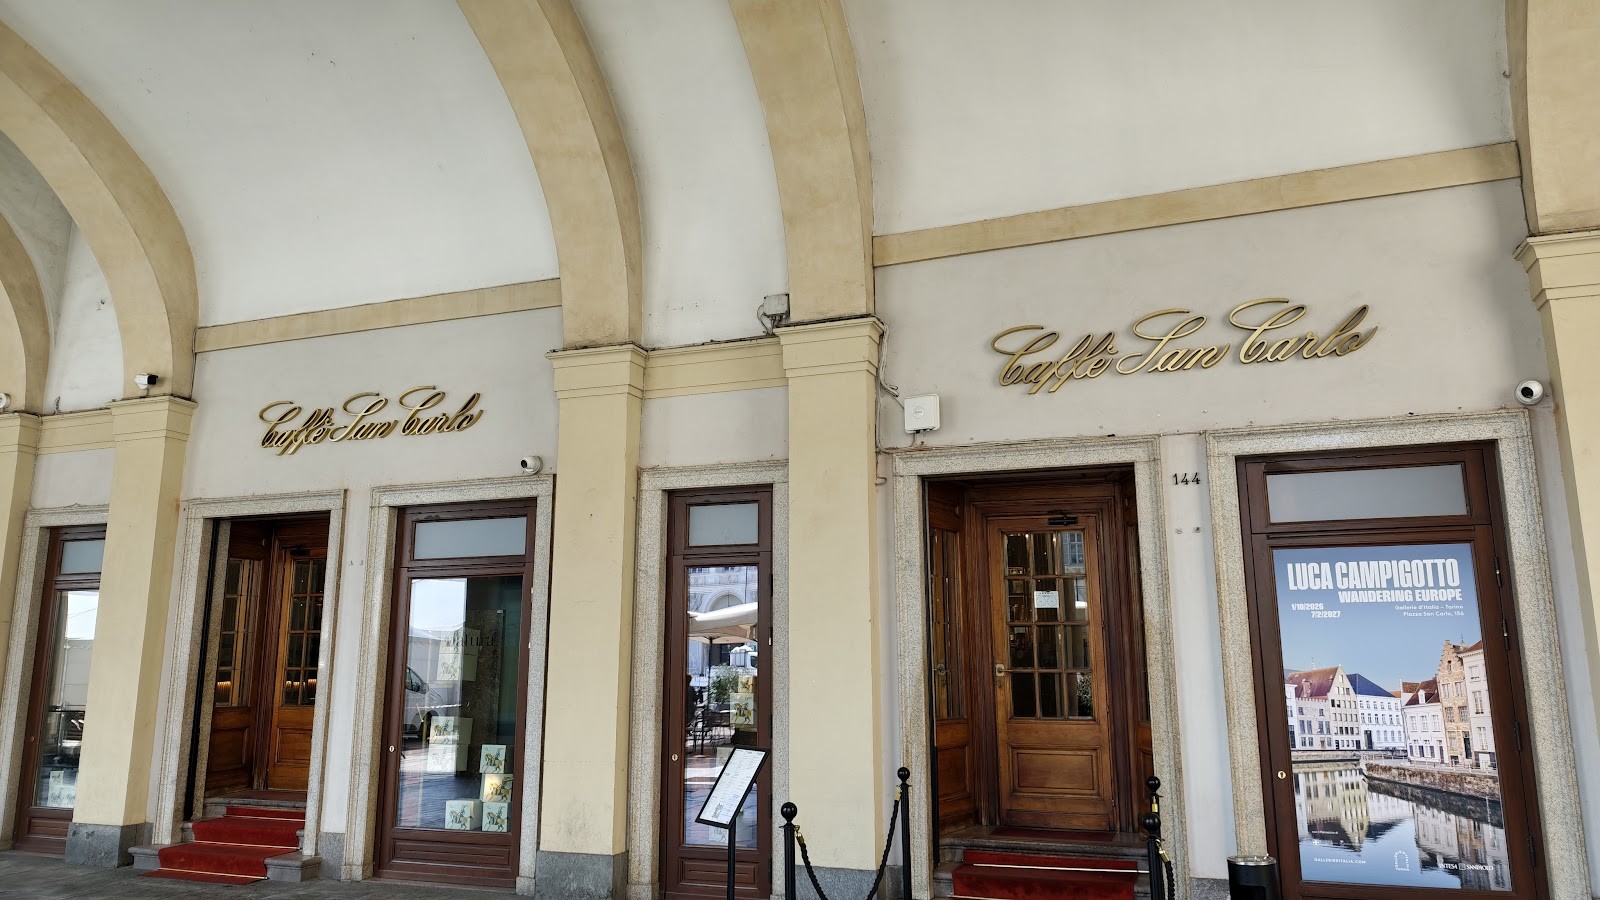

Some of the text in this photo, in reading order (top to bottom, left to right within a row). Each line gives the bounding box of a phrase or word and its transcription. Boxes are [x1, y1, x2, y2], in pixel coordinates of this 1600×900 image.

[991, 297, 1378, 395] Caffè San Carlo
[258, 385, 484, 456] Caffè San Carlo
[1173, 472, 1201, 485] 144
[1287, 558, 1461, 591] LUCA CAMPIGOTTO
[1291, 602, 1324, 611] 1/10/2026
[1338, 588, 1463, 603] WANDERING EUROPE
